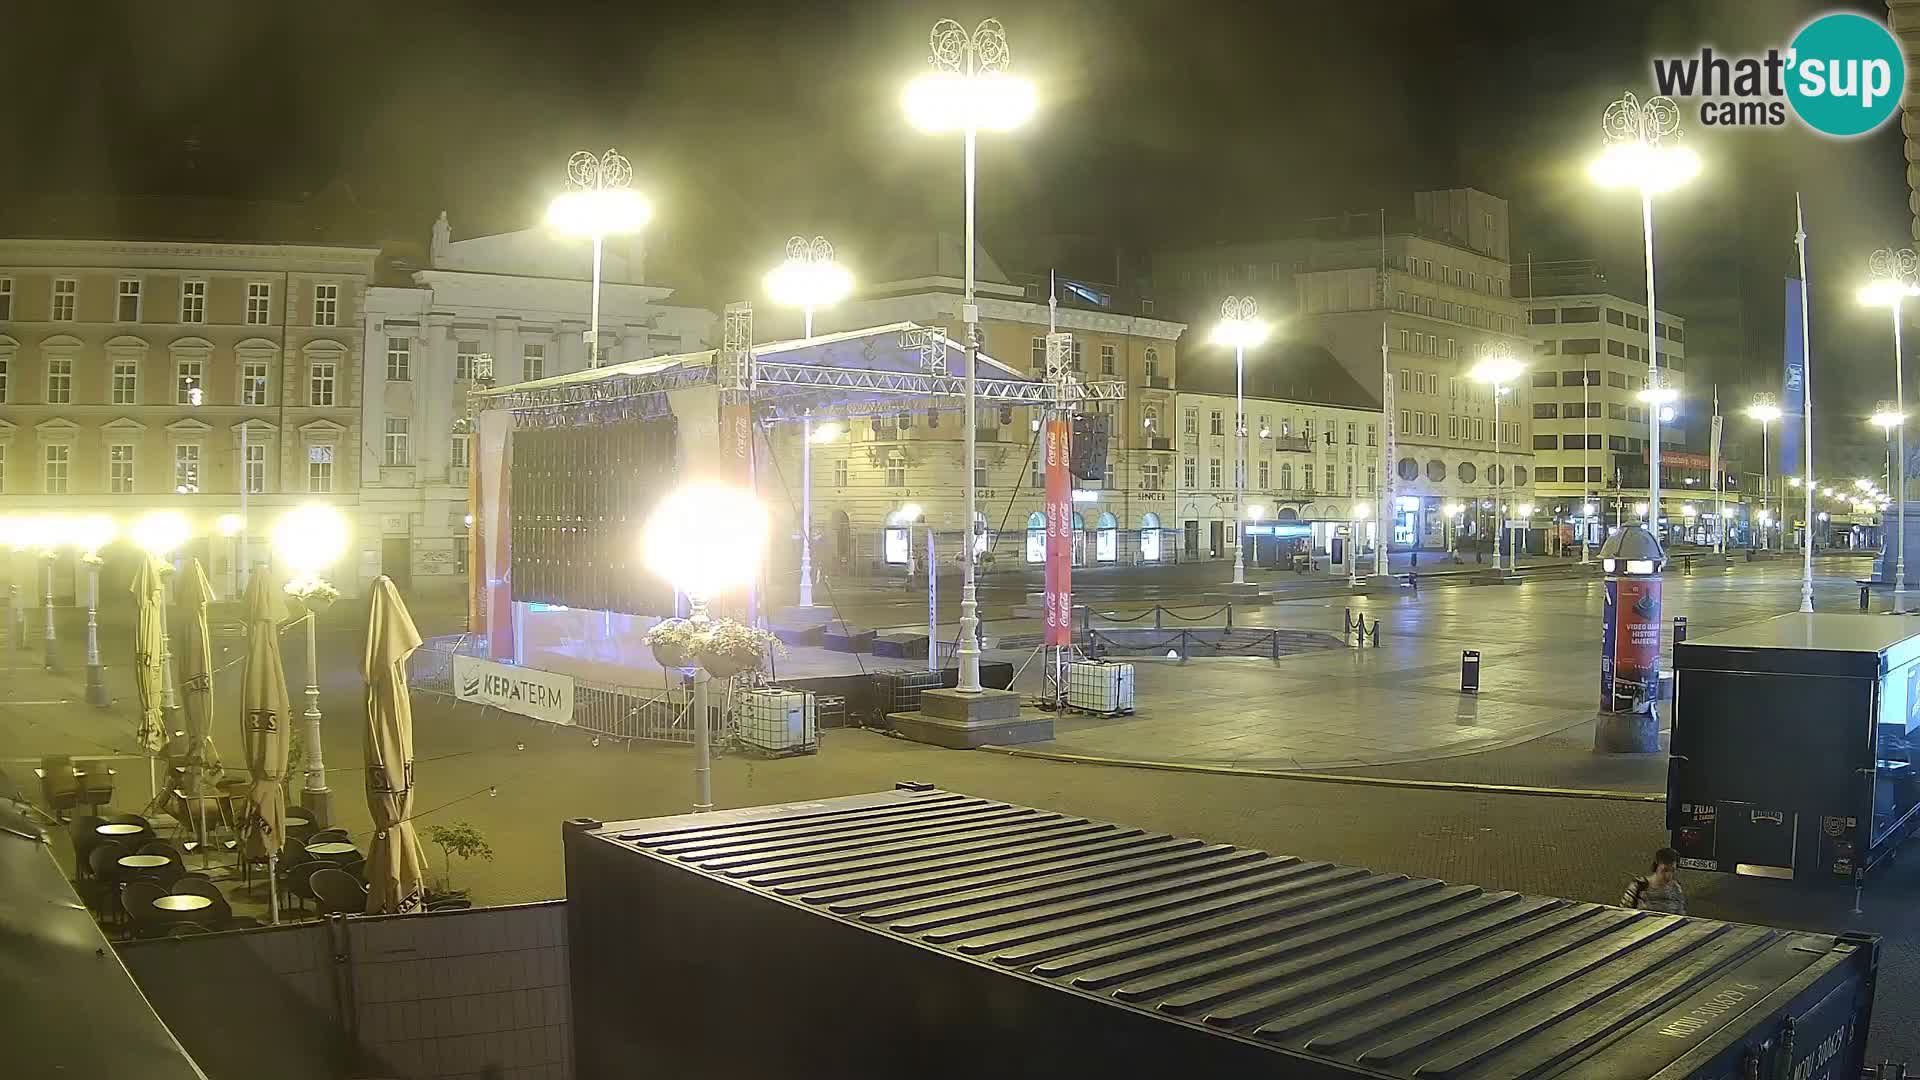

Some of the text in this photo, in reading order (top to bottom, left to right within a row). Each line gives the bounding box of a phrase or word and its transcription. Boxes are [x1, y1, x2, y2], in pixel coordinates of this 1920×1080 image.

[1138, 492, 1165, 501] SINGER
[484, 673, 562, 710] KERATERM
[1692, 989, 1747, 1018] 300629
